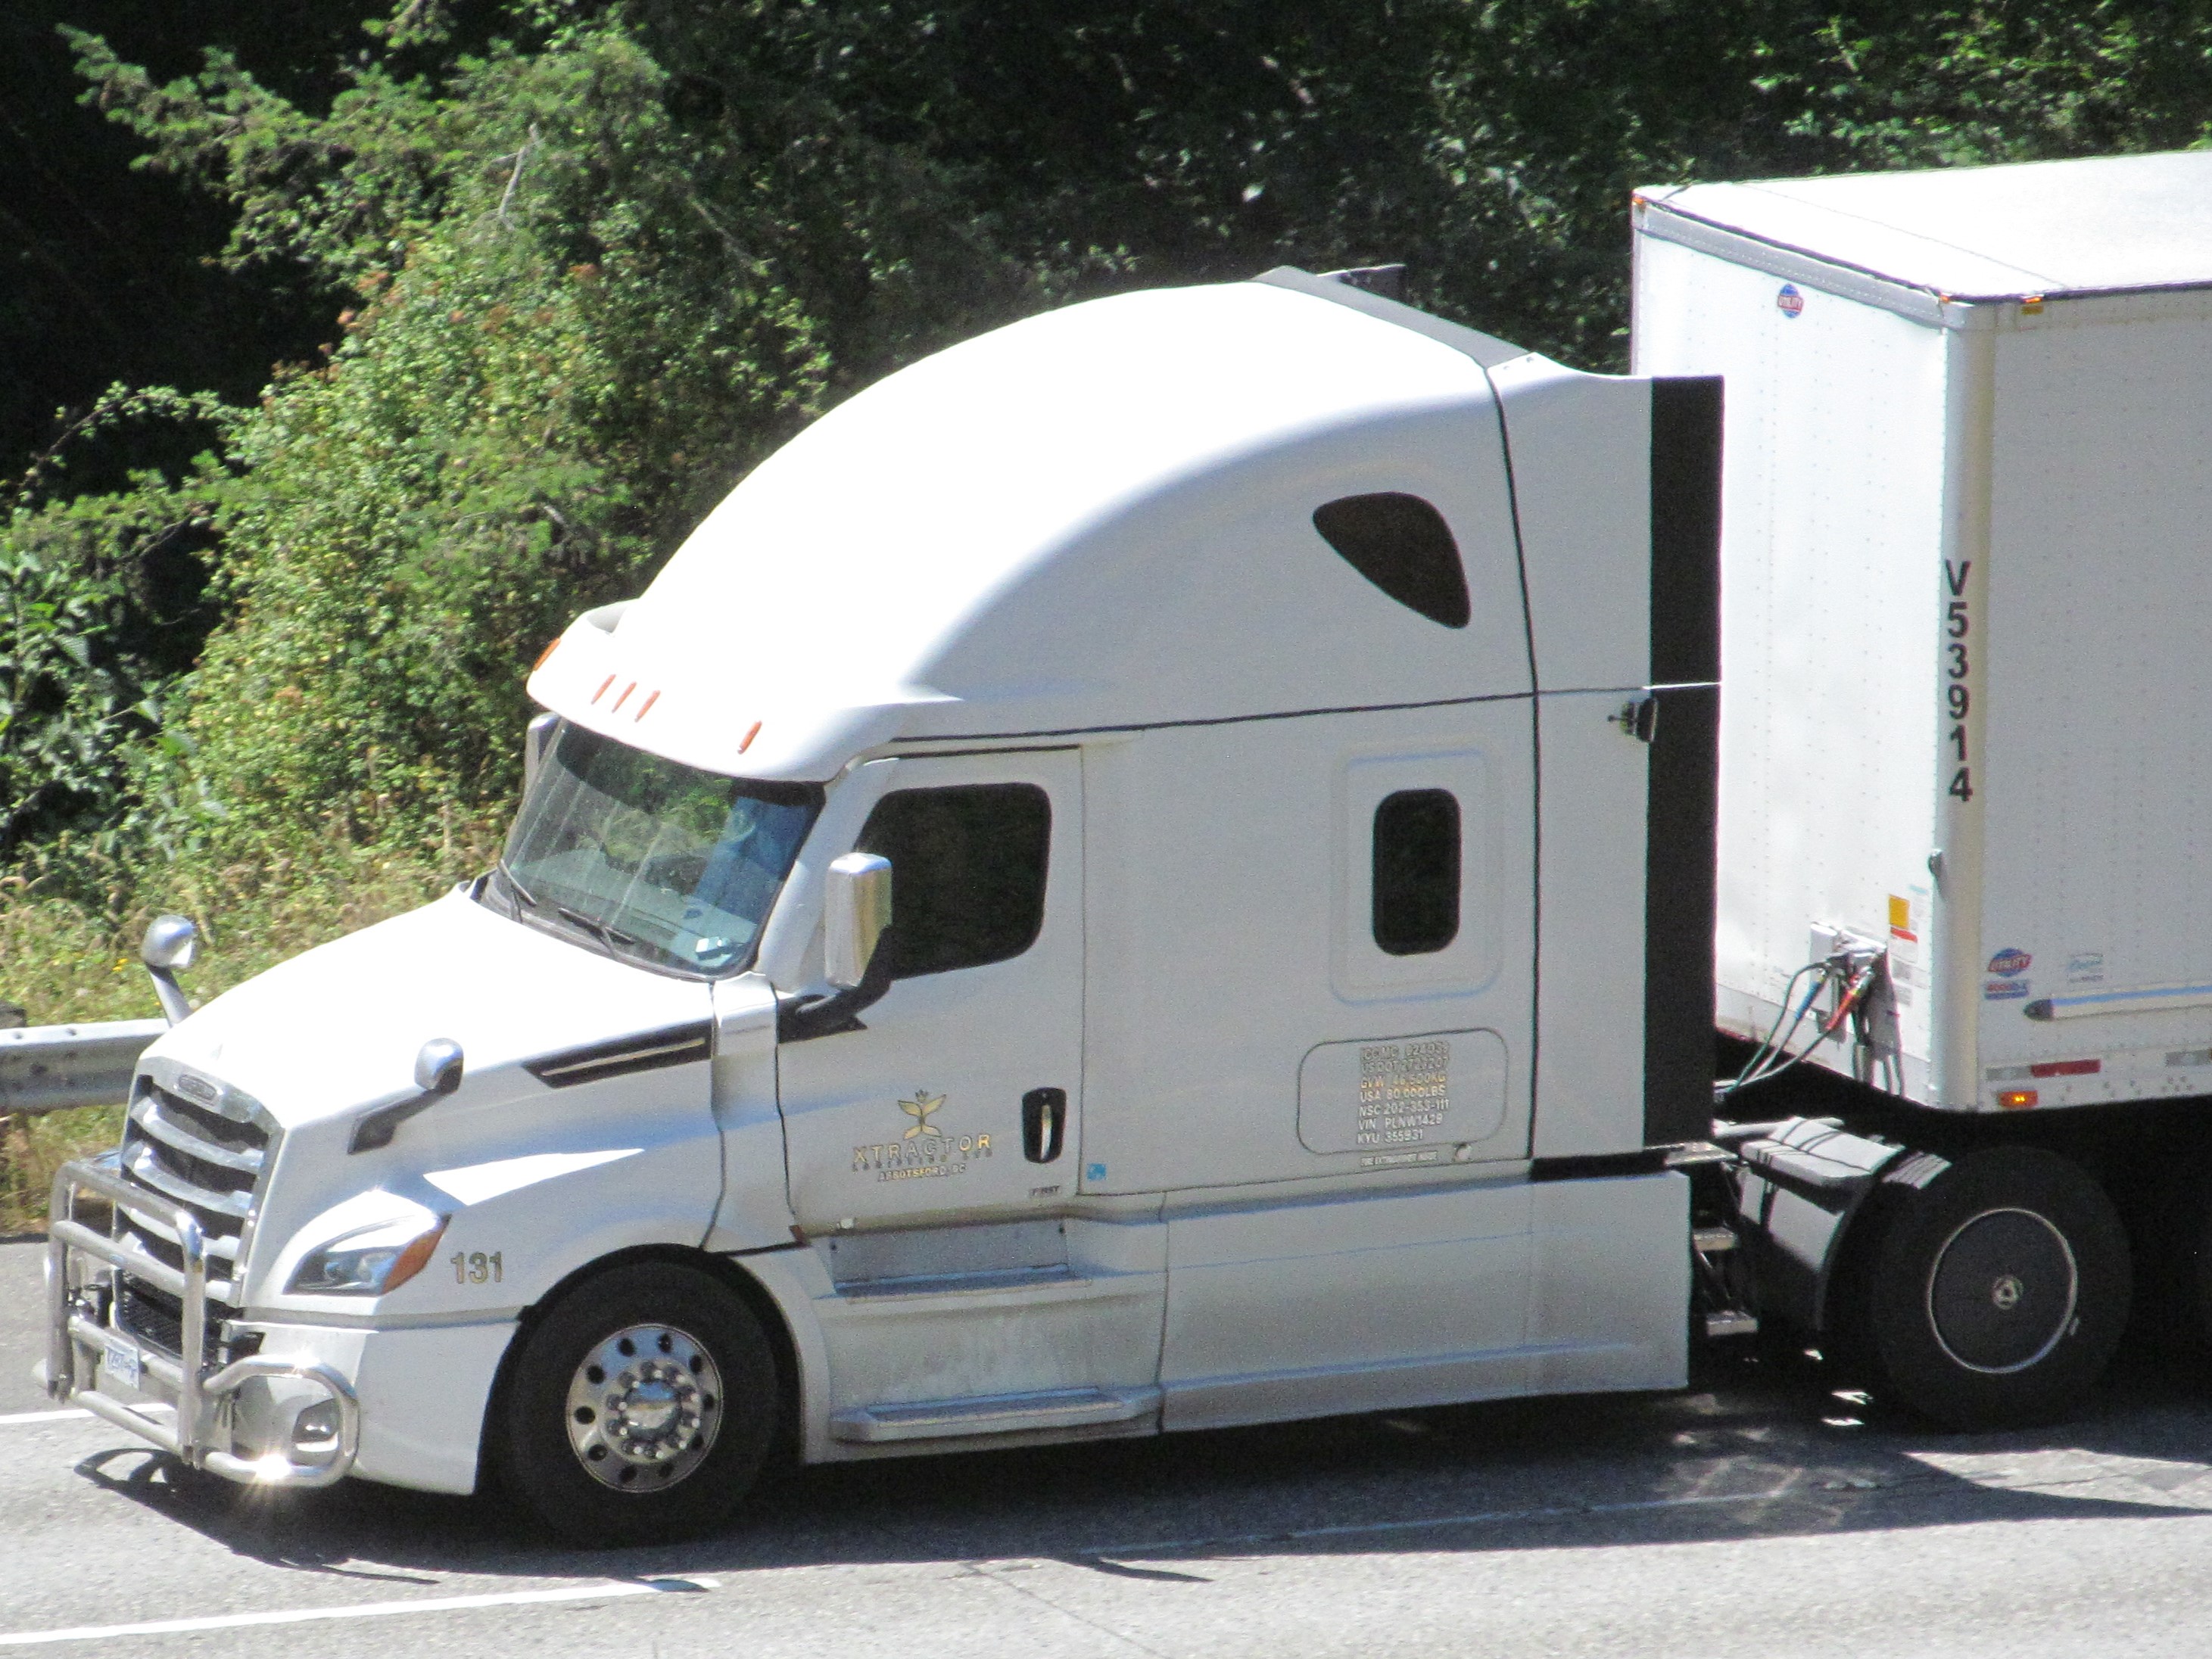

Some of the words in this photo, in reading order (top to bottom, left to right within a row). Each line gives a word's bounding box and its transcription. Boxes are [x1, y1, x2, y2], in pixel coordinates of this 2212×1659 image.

[1945, 559, 1974, 802] V53914
[1360, 1090, 1382, 1103] USA
[1359, 1104, 1382, 1117] NSC
[1359, 1119, 1377, 1131] VIN
[1357, 1132, 1380, 1144] KYU
[852, 1133, 992, 1164] XTRACTOR
[450, 1250, 503, 1284] 131
